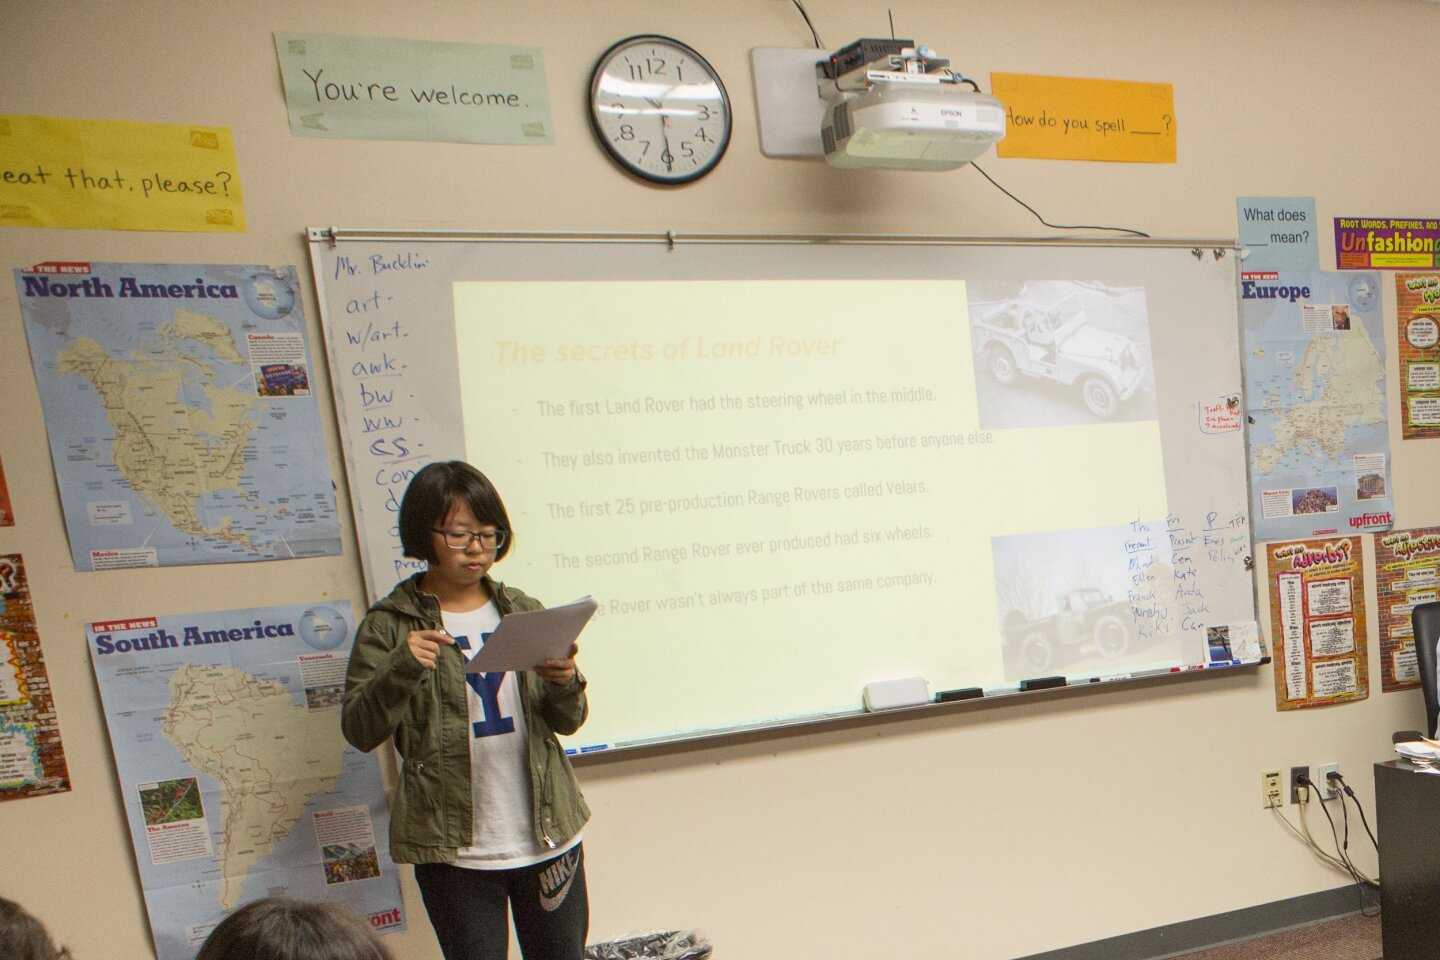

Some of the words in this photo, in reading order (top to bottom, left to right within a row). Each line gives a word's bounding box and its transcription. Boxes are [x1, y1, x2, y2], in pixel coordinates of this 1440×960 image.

[645, 57, 667, 75] 12
[302, 68, 399, 102] You're
[410, 85, 529, 108] welcome.
[696, 104, 710, 121] 3
[940, 109, 962, 117] EPSON
[1038, 110, 1057, 127] do
[1063, 118, 1089, 134] you
[1095, 117, 1125, 136] spell
[619, 124, 635, 141] 8
[694, 127, 707, 142] 4
[637, 140, 650, 156] 7
[681, 141, 694, 157] 5
[141, 171, 232, 198] please?
[1244, 207, 1274, 221] What
[1277, 208, 1306, 222] does
[1340, 219, 1360, 229] ROOT
[1427, 221, 1438, 230] AND
[1270, 230, 1310, 244] mean?
[22, 276, 114, 299] North
[119, 277, 239, 299] America
[1241, 280, 1311, 302] Europe
[494, 340, 546, 364] The
[556, 339, 653, 362] secrets
[662, 336, 690, 360] of
[696, 336, 761, 359] Land
[768, 335, 842, 358] Rover
[537, 400, 565, 417] The
[569, 399, 602, 416] first
[605, 397, 641, 415] Land
[645, 396, 686, 413] Rover
[689, 395, 716, 411] had
[719, 394, 743, 411] the
[746, 390, 804, 410] steering
[807, 389, 847, 407] wheel
[850, 389, 863, 404] in
[866, 388, 888, 404] the
[890, 386, 938, 403] middle.
[541, 451, 577, 471] They
[581, 449, 615, 467] also
[618, 447, 682, 465] invented
[685, 446, 710, 462] the
[712, 442, 770, 460] Monster
[773, 438, 812, 456] Truck
[815, 436, 834, 454] 30
[836, 436, 873, 455] years
[875, 433, 917, 451] before
[919, 432, 965, 451] anyone
[547, 502, 576, 520] The
[579, 500, 612, 518] first
[615, 498, 637, 516] 25
[639, 490, 745, 518] pre-production
[747, 488, 792, 508] Range
[793, 486, 841, 503] Rovers
[843, 481, 884, 499] called
[1348, 511, 1393, 529] upfront
[553, 553, 581, 571] The
[585, 548, 640, 569] second
[642, 545, 689, 566] Range
[691, 541, 733, 559] Rover
[735, 539, 766, 556] ever
[768, 533, 832, 556] produced
[834, 529, 860, 547] had
[862, 526, 883, 545] six
[884, 525, 936, 543] wheels.
[94, 624, 105, 633] IN
[108, 622, 128, 632] THE
[130, 620, 157, 631] NEWS
[95, 630, 179, 655] South
[183, 621, 295, 647] America
